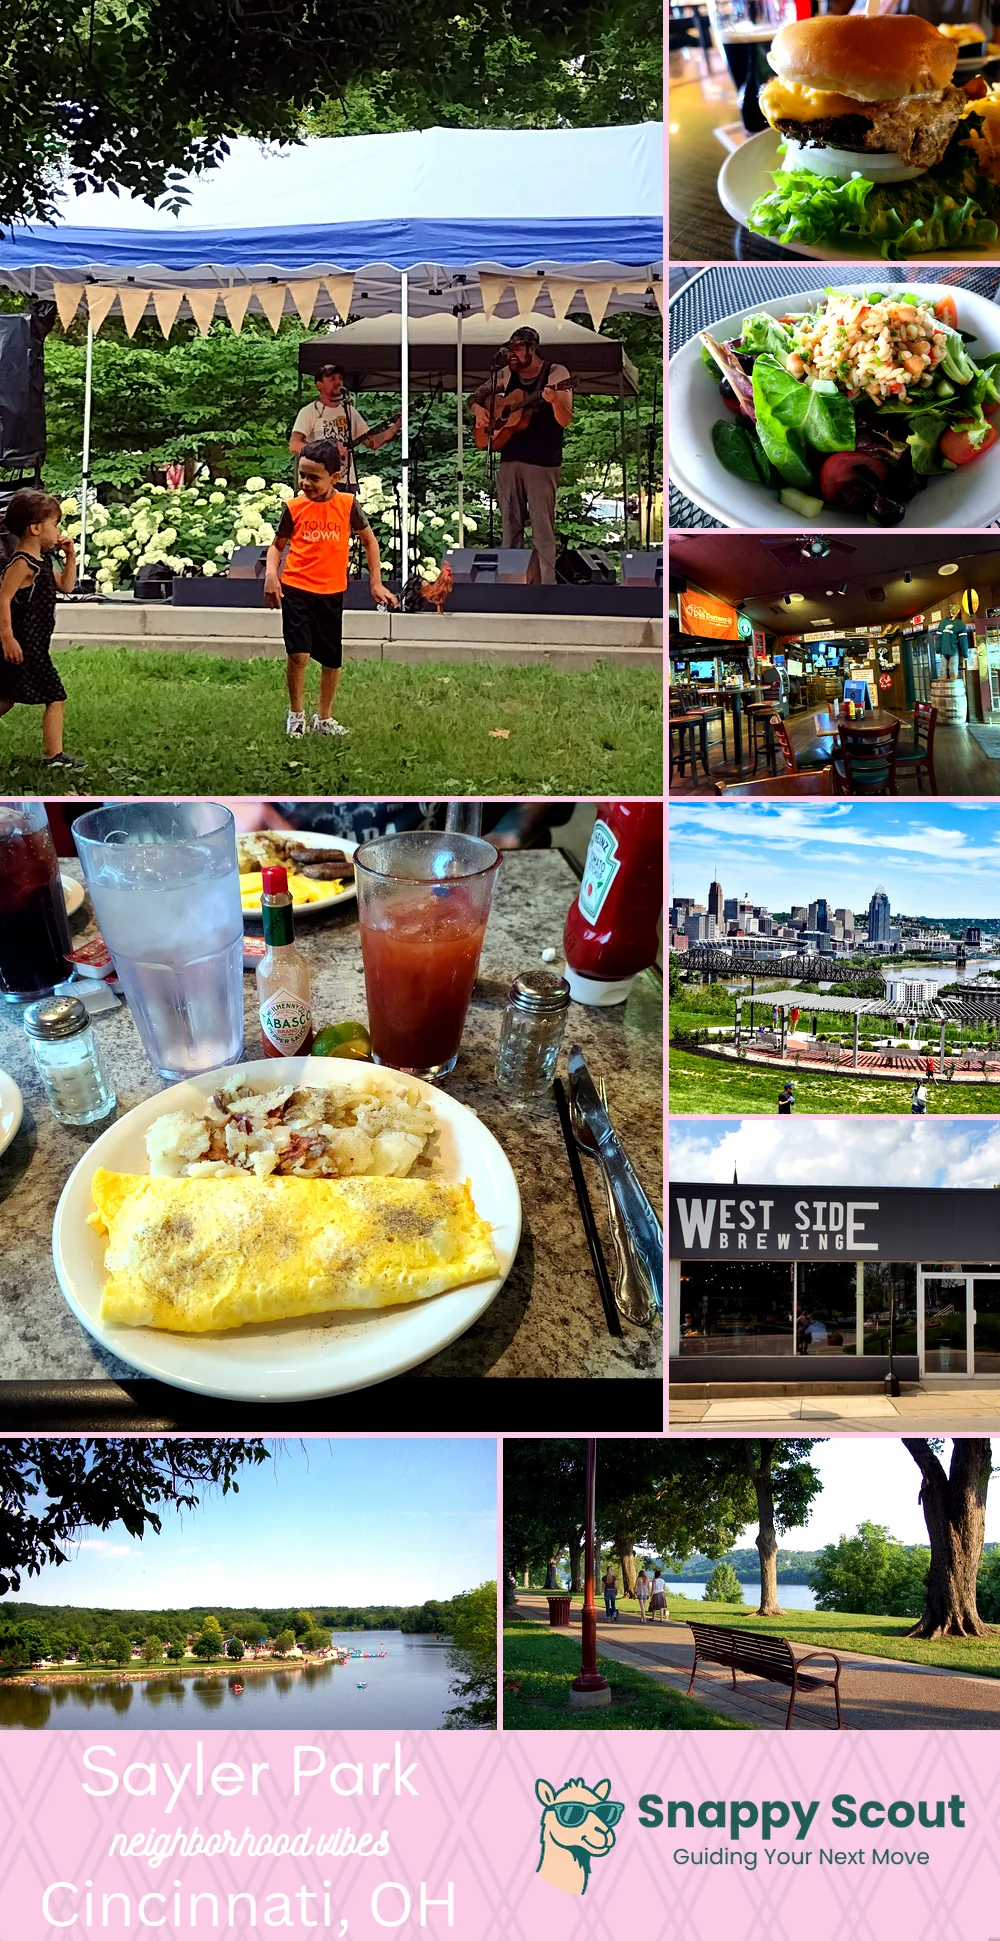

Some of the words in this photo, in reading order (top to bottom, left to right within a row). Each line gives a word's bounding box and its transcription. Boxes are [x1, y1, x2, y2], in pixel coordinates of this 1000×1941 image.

[304, 520, 341, 532] TOUCH
[303, 530, 340, 541] DOWN
[261, 1010, 311, 1029] TABASCO
[267, 1027, 290, 1044] PEPPER
[676, 1198, 774, 1249] WEST
[794, 1200, 879, 1251] SIDE
[719, 1232, 844, 1250] BREWING
